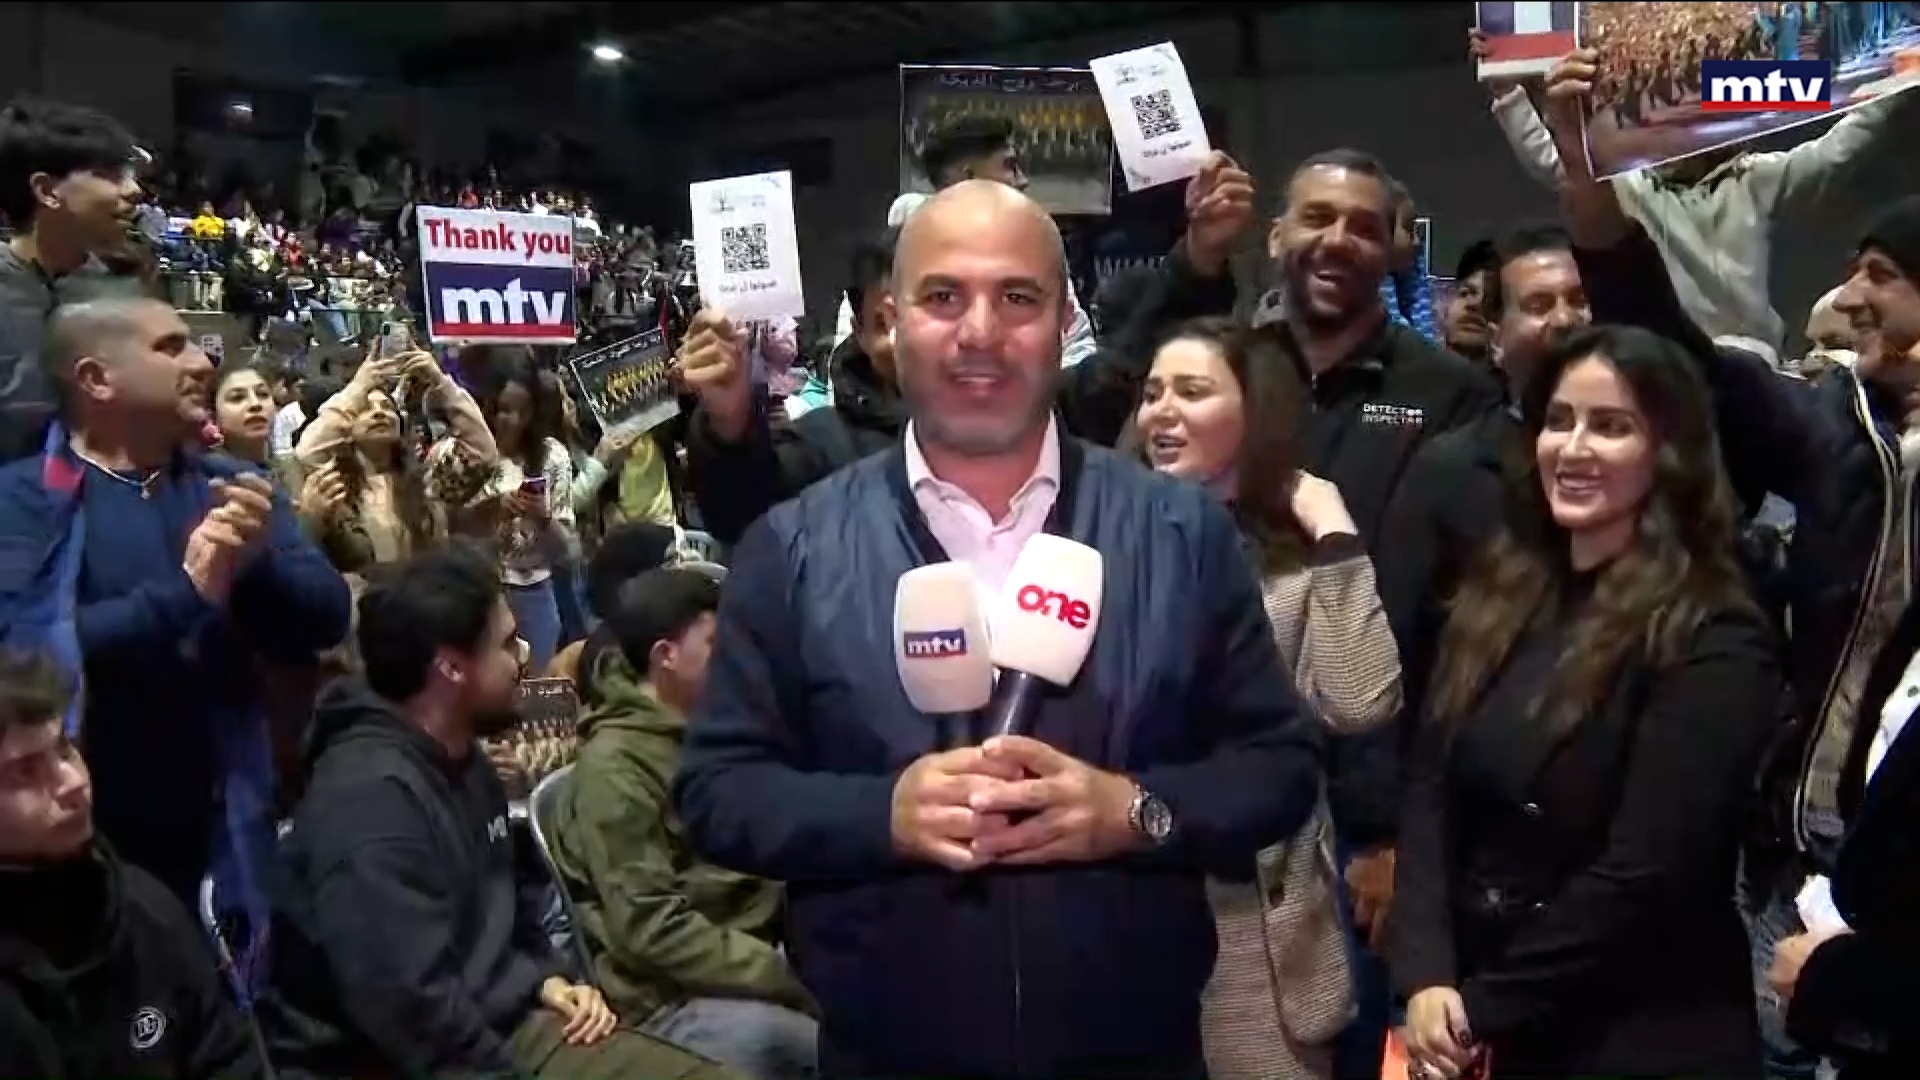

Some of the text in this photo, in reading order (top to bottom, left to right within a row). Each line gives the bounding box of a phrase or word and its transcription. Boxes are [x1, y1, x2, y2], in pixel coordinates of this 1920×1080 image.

[424, 217, 571, 261] Thank you
[441, 277, 567, 326] mtv
[1016, 584, 1091, 630] one
[908, 635, 961, 655] mtv
